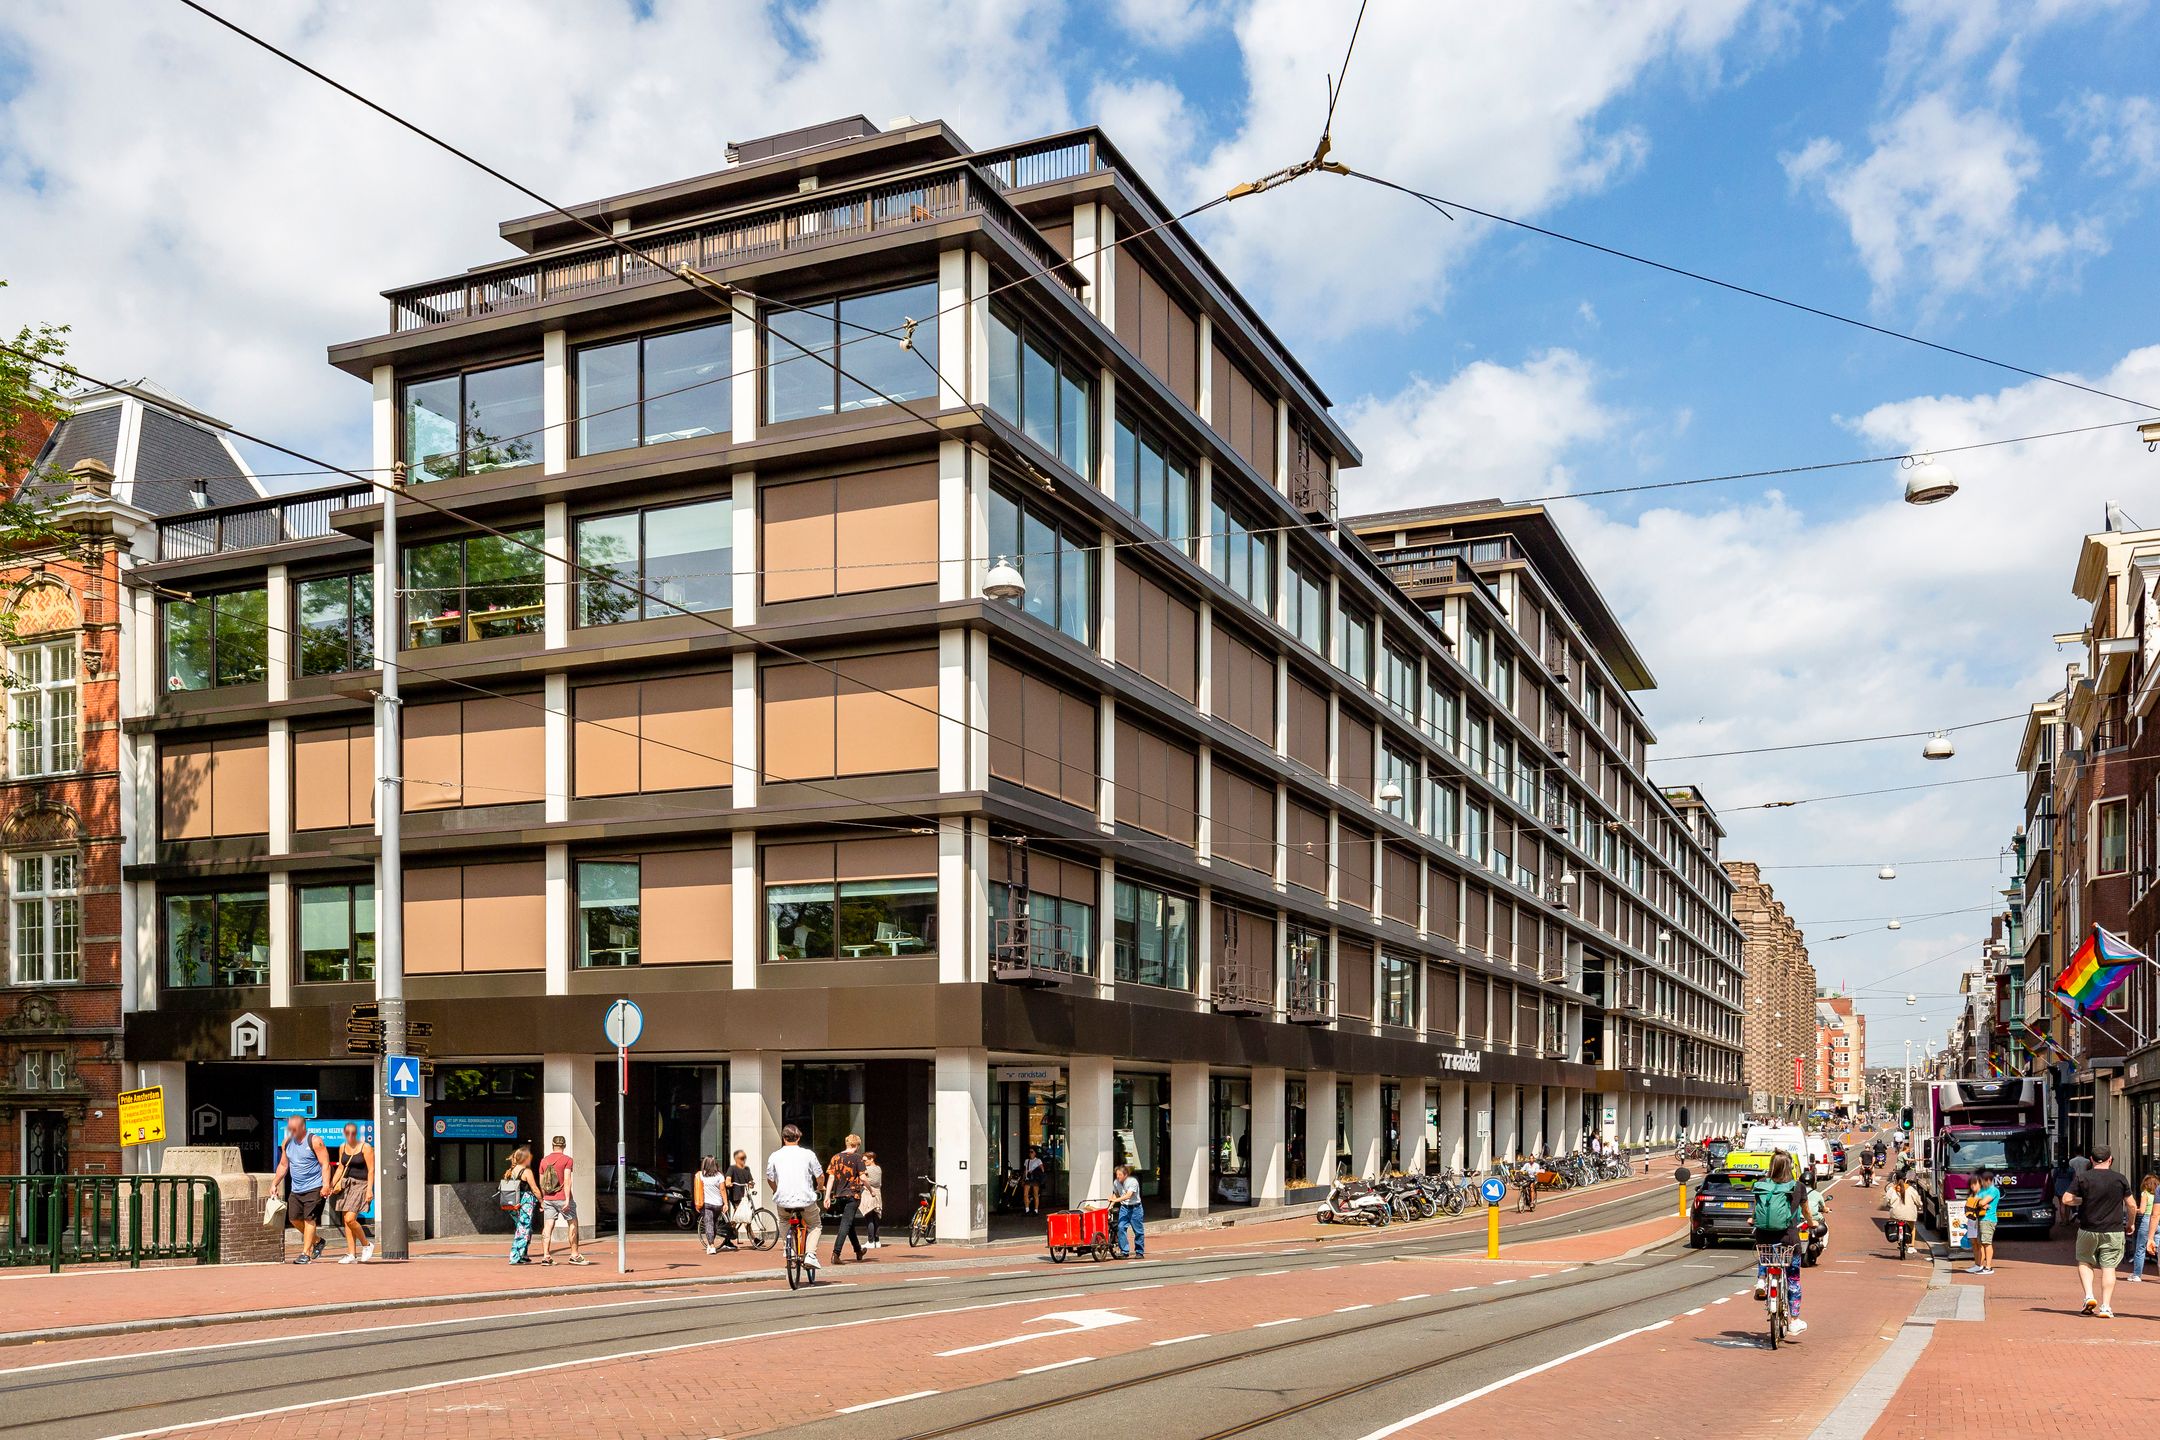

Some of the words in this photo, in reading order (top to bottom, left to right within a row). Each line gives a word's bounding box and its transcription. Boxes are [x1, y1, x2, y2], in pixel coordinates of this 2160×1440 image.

[237, 1027, 258, 1056] P
[1018, 1070, 1047, 1079] randstad
[120, 1095, 134, 1104] Pride
[134, 1091, 160, 1102] Amsterdam
[198, 1111, 218, 1136] P
